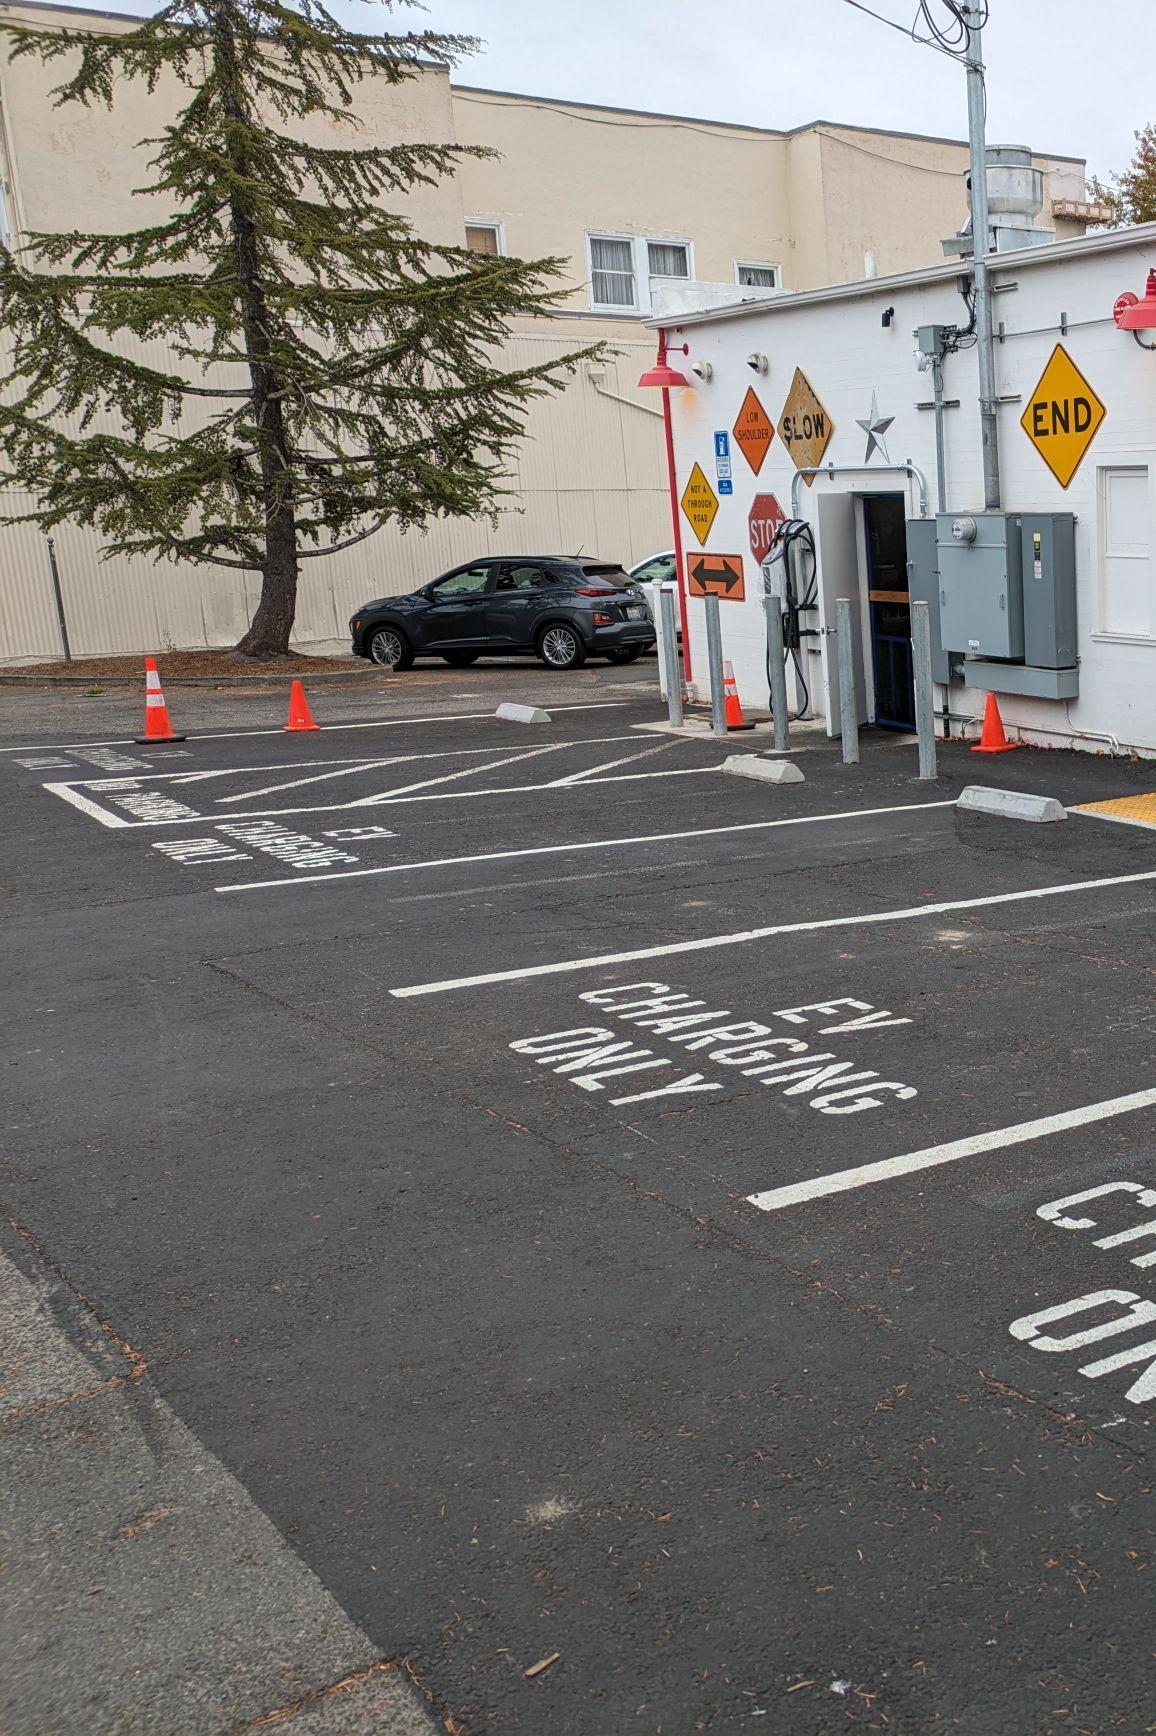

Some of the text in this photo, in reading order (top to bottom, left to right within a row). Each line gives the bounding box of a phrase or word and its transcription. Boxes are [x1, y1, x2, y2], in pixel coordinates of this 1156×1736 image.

[746, 412, 759, 423] LOW
[783, 413, 825, 442] SLOW
[1033, 397, 1092, 437] END
[738, 428, 769, 441] SHOULDER
[690, 485, 707, 494] NOT A
[687, 499, 713, 509] THROUGH
[693, 513, 708, 523] ROAD
[214, 821, 359, 868] CHARGING
[322, 826, 400, 841] EV
[151, 838, 253, 865] ONLY
[772, 997, 913, 1034] EV
[579, 982, 918, 1114] CHARGING
[509, 1026, 724, 1105] ONLY
